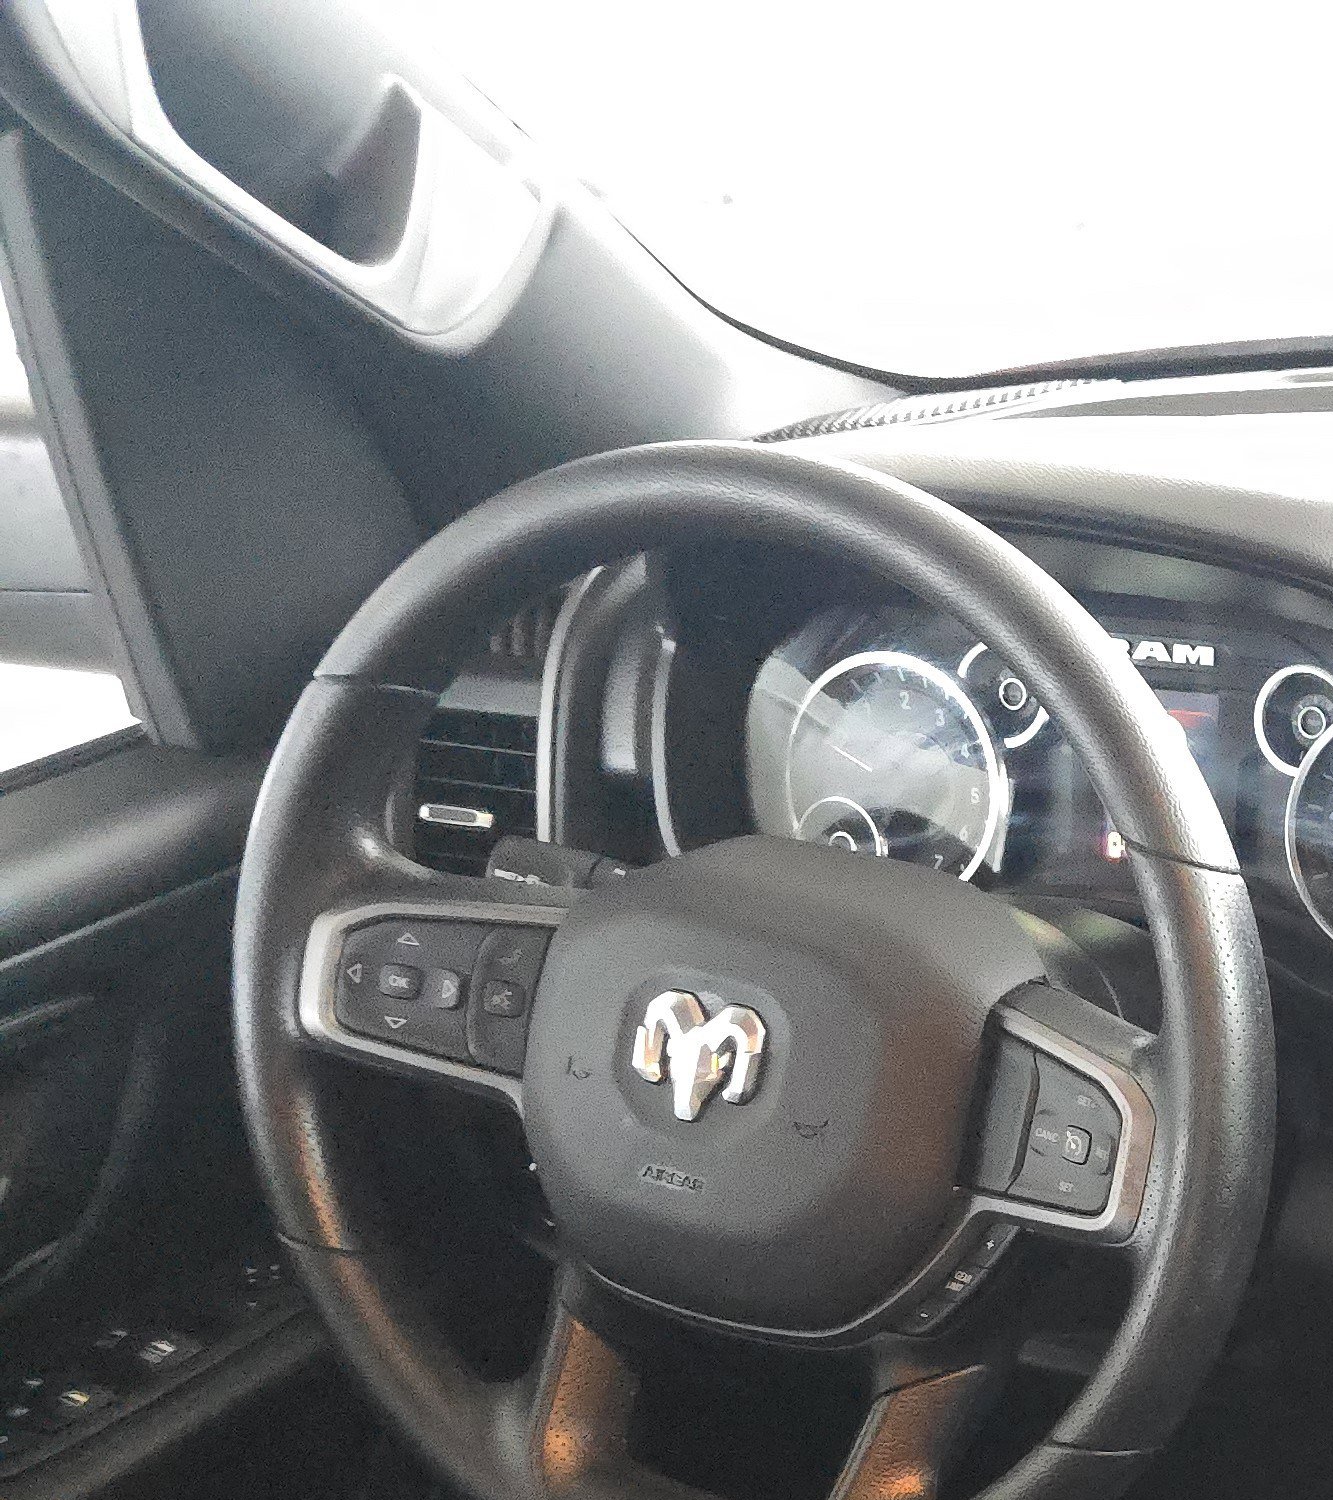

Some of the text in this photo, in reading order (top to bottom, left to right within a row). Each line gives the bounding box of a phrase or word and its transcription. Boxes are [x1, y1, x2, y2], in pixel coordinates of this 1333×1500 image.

[970, 787, 980, 804] 5
[933, 853, 944, 870] 7
[388, 973, 411, 989] OK
